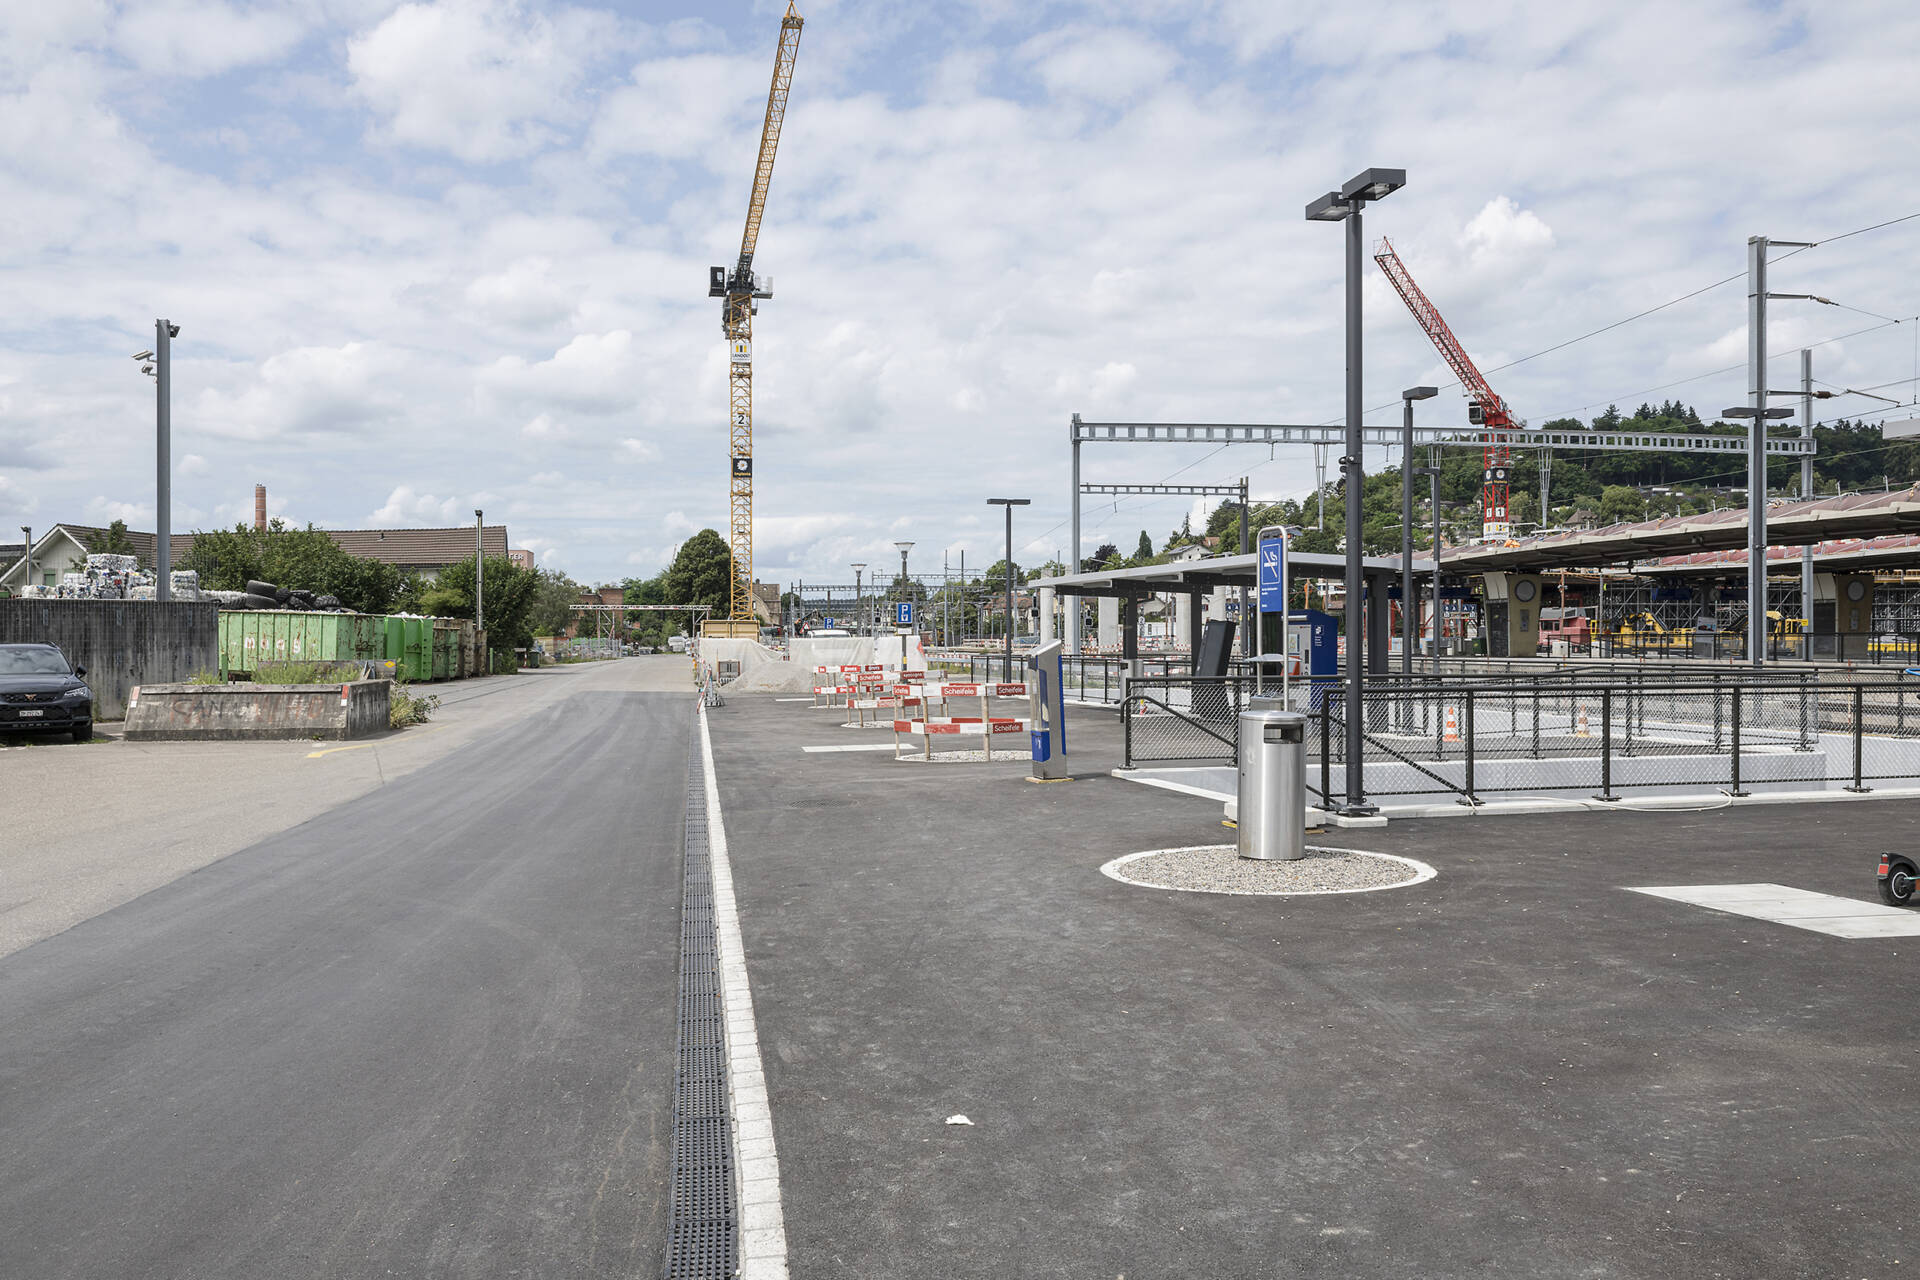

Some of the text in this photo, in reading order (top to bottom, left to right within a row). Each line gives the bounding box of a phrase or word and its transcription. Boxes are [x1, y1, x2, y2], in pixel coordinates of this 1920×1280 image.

[738, 414, 745, 424] 2
[901, 604, 909, 614] P
[943, 686, 975, 695] Scheifele
[998, 685, 1023, 694] Scheifele
[994, 724, 1020, 733] Scheifele
